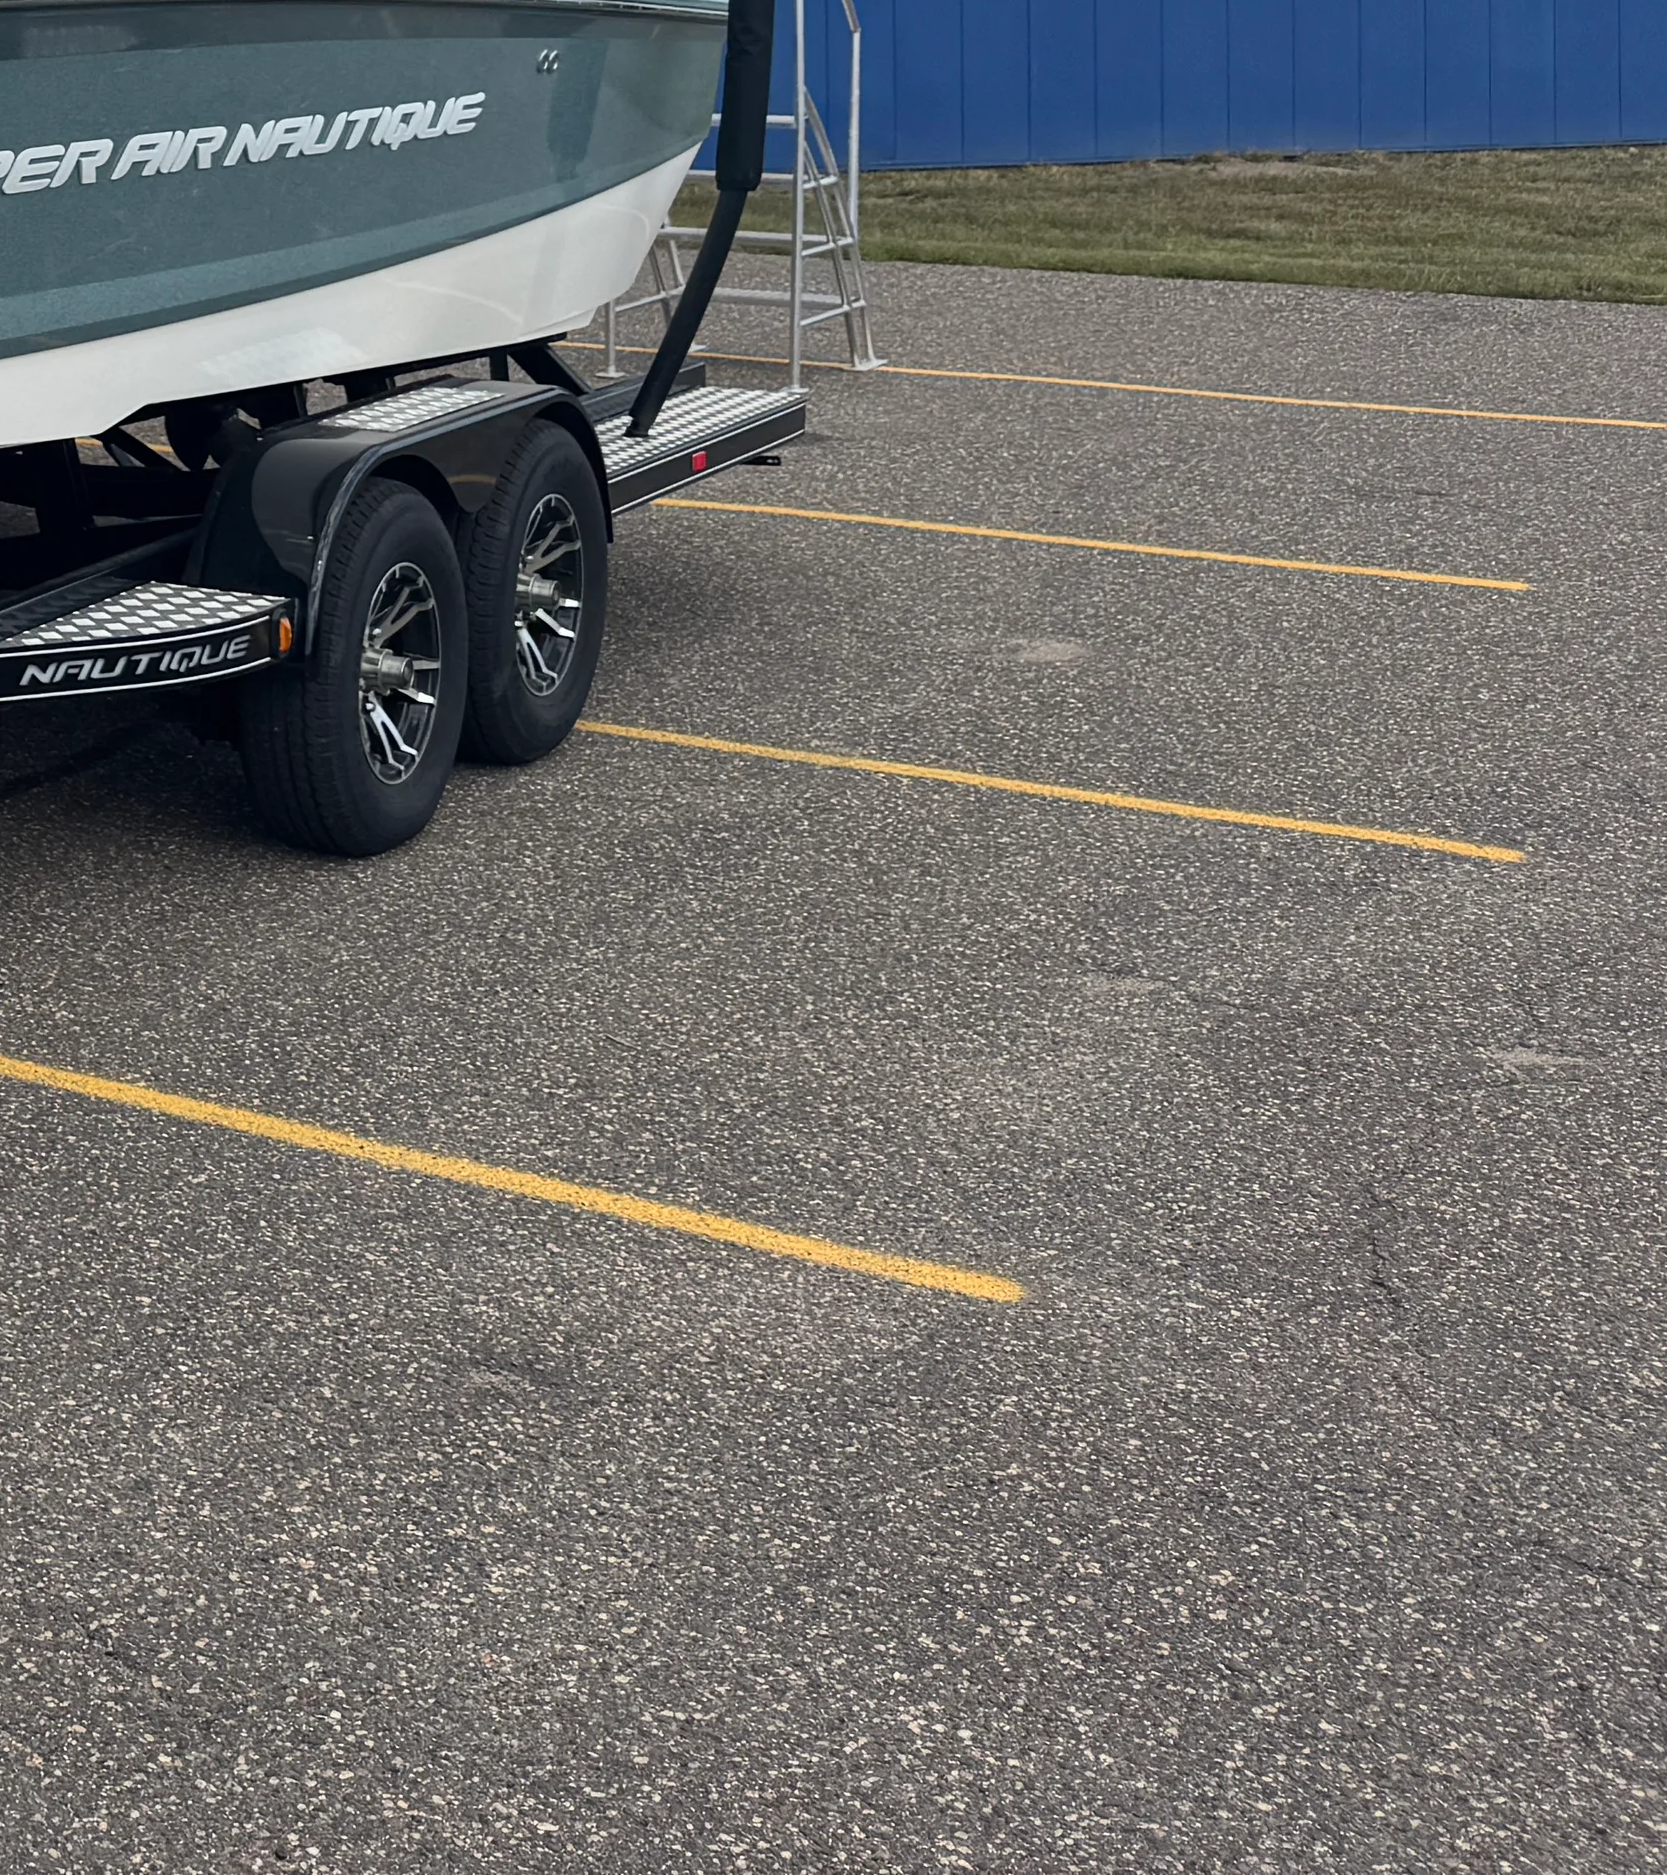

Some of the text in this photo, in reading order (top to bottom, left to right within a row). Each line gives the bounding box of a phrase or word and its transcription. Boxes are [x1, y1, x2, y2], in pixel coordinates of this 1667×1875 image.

[110, 126, 228, 181] AIR
[222, 91, 486, 168] NAUTIQUE
[19, 635, 251, 686] NAUTIQUE
